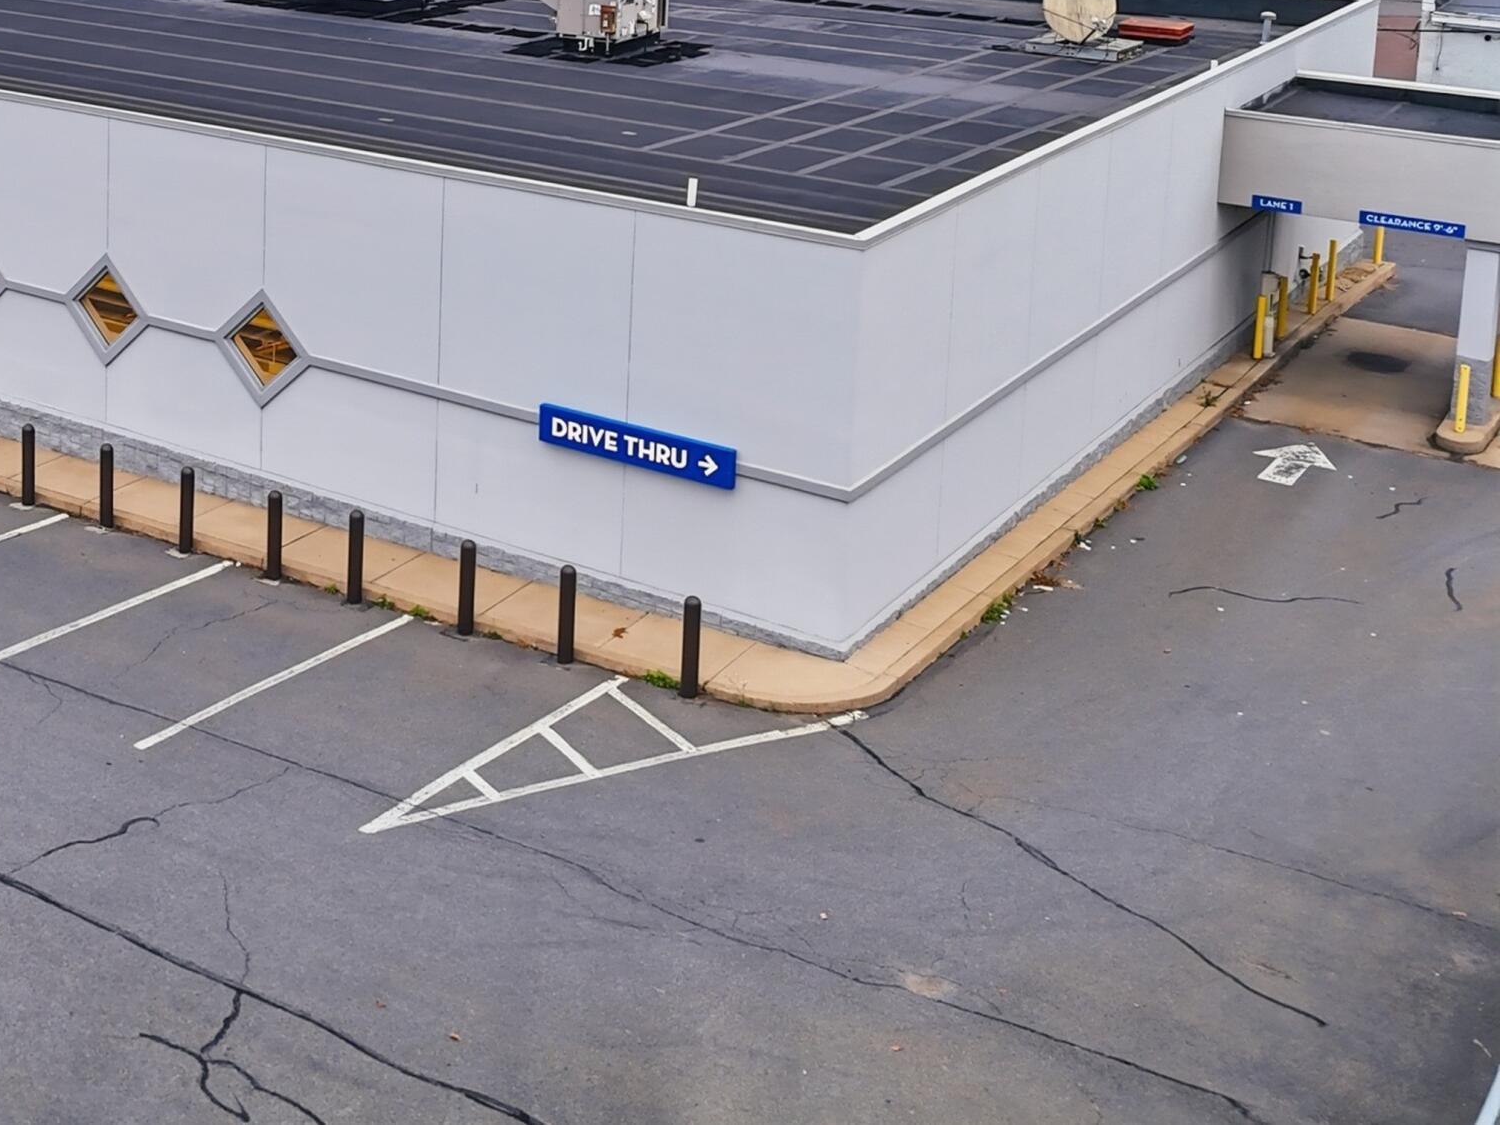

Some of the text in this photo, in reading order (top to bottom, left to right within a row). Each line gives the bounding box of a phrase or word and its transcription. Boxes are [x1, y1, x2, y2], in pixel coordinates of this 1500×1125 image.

[1260, 198, 1294, 211] LANE 1
[1365, 214, 1432, 231] CLEARANCE
[551, 416, 687, 469] DRIVE THRU
